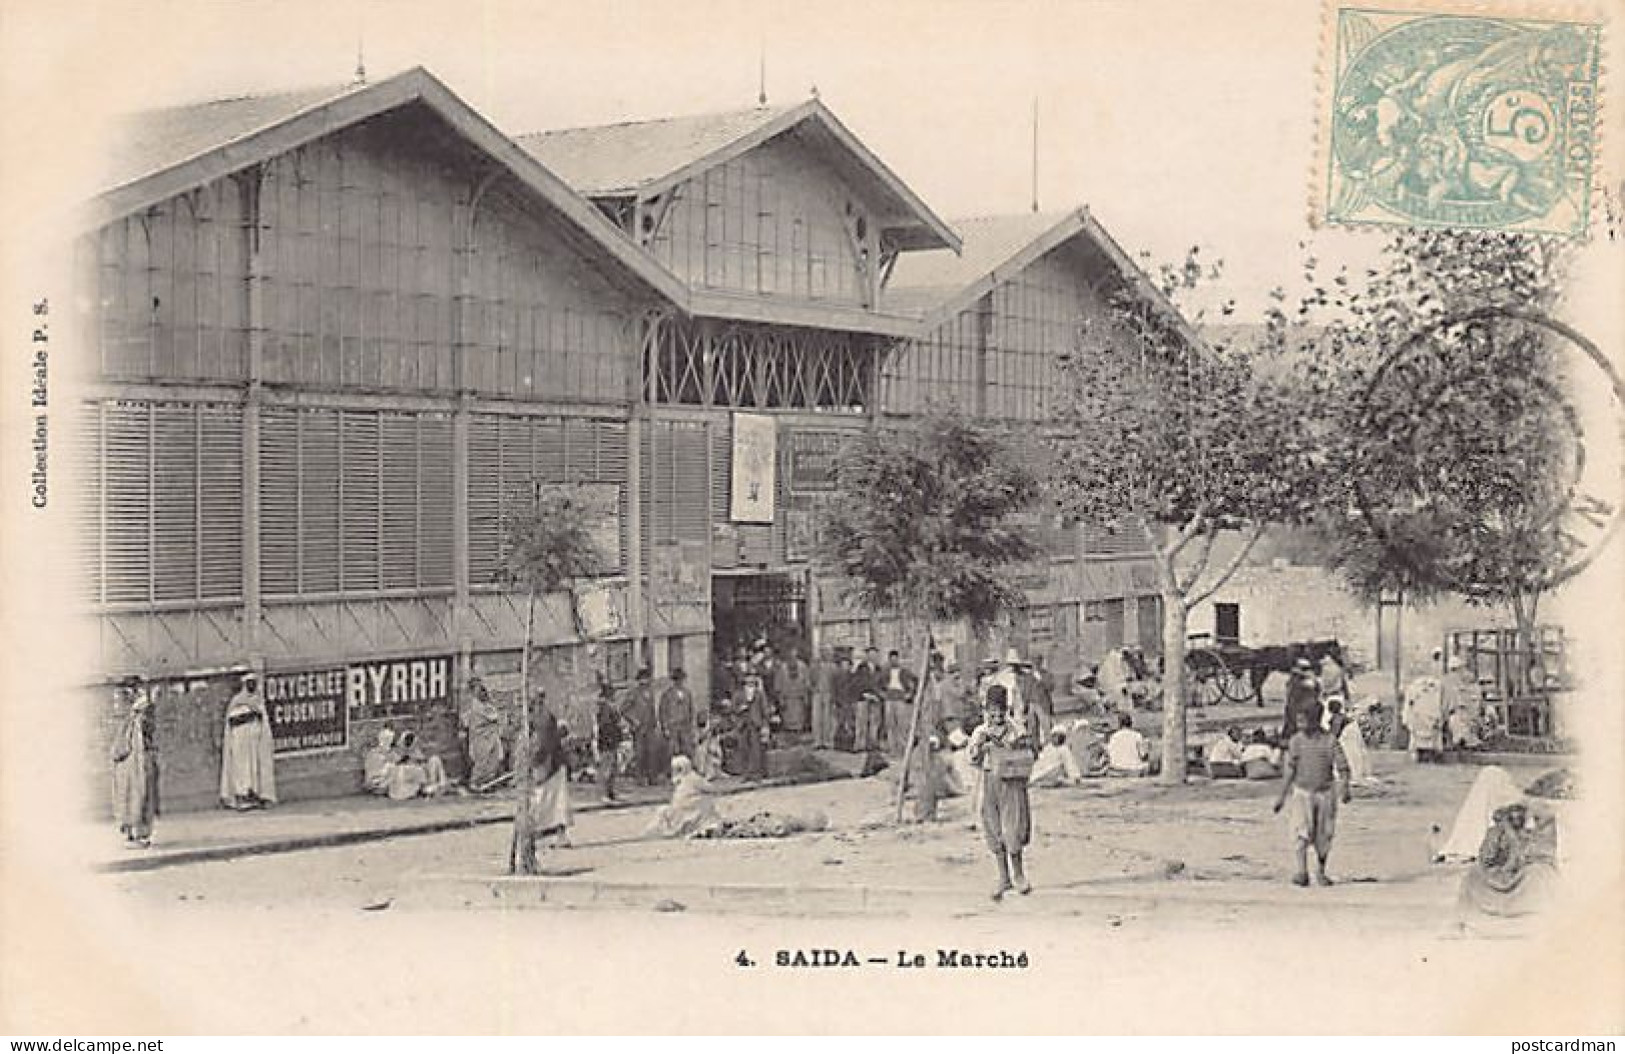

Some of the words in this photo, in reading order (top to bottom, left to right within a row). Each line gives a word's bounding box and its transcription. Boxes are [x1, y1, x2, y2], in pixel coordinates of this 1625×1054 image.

[33, 298, 48, 316] S.
[33, 323, 48, 342] P.
[32, 350, 48, 407] Idéale
[32, 414, 48, 508] Collection
[348, 659, 447, 708] BYRRH
[735, 949, 756, 967] 4.
[776, 949, 861, 967] SAIDA
[898, 950, 926, 968] Le
[937, 949, 1029, 968] Marché
